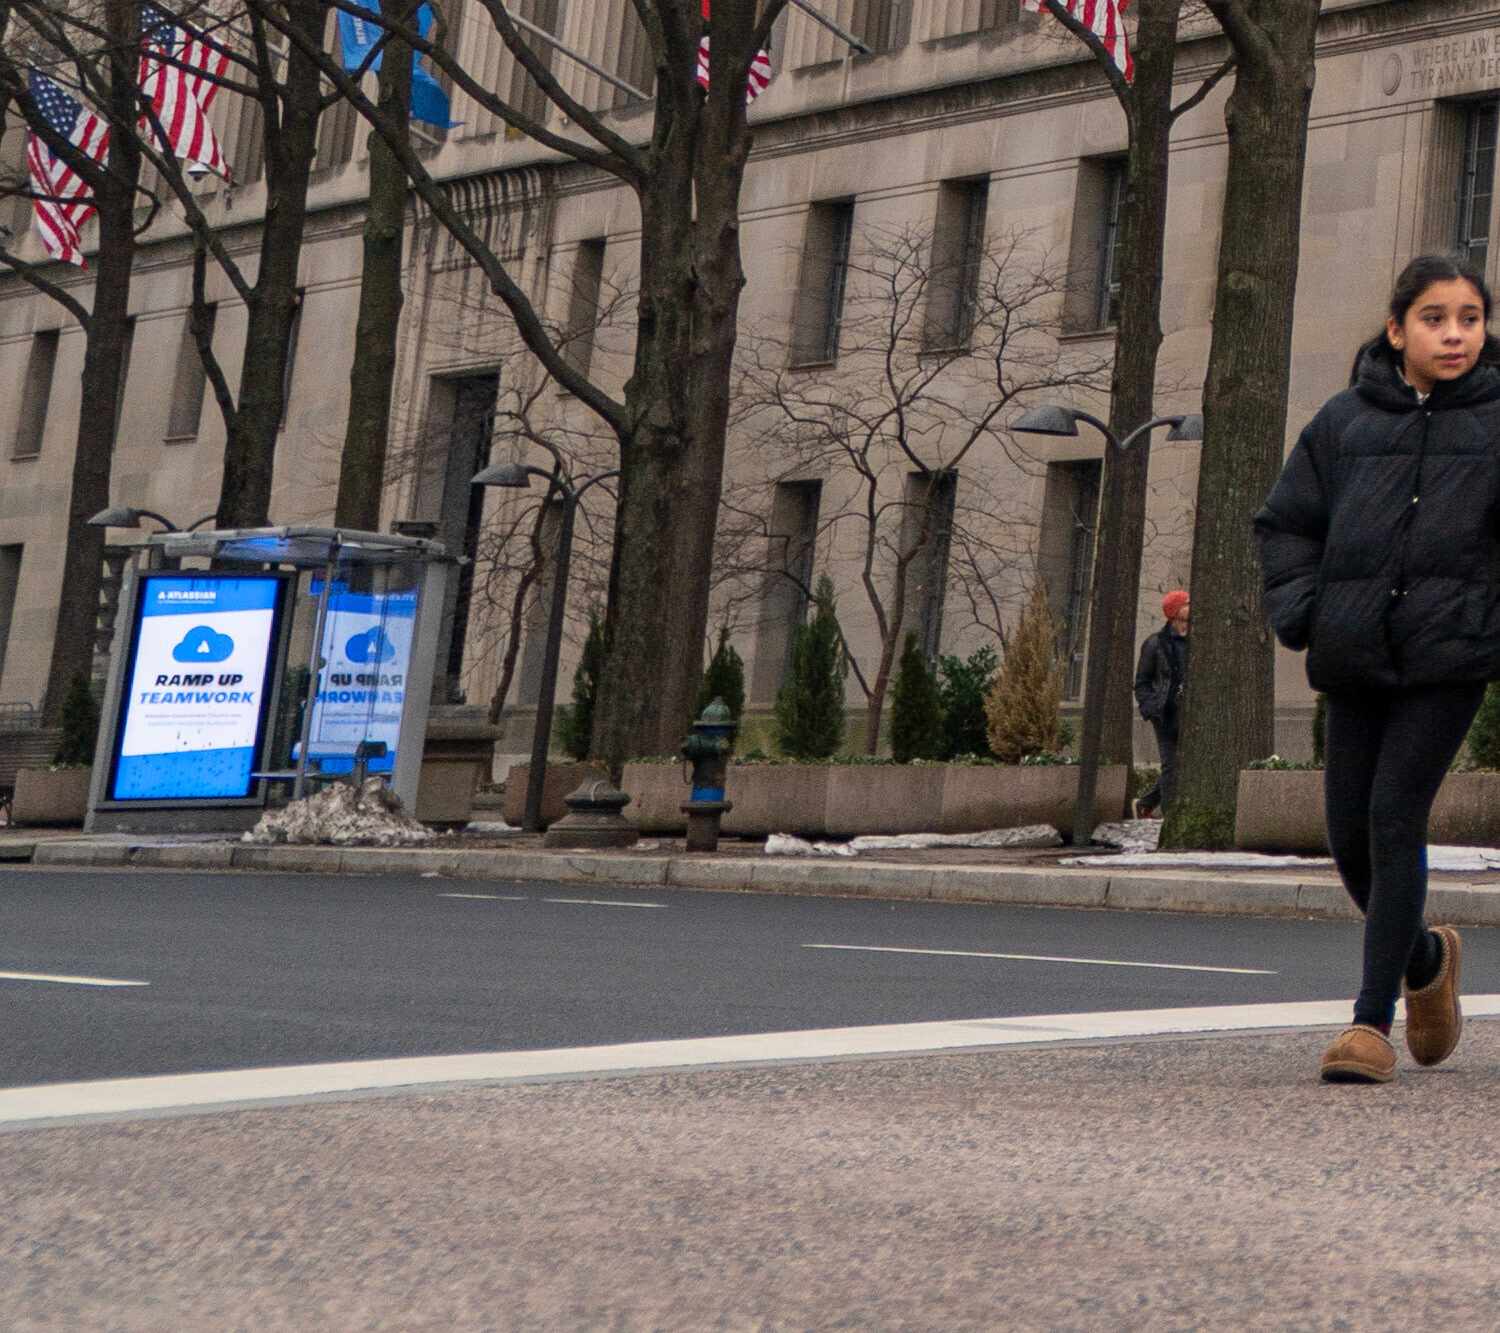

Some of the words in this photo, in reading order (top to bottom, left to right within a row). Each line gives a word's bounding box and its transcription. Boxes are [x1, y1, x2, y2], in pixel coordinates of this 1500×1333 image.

[1413, 42, 1458, 66] WHERE
[1463, 36, 1491, 59] LAW
[1410, 61, 1476, 89] TYRANNY
[155, 674, 214, 686] RAMP
[218, 674, 243, 686] UP
[140, 691, 254, 704] TEAMWORK
